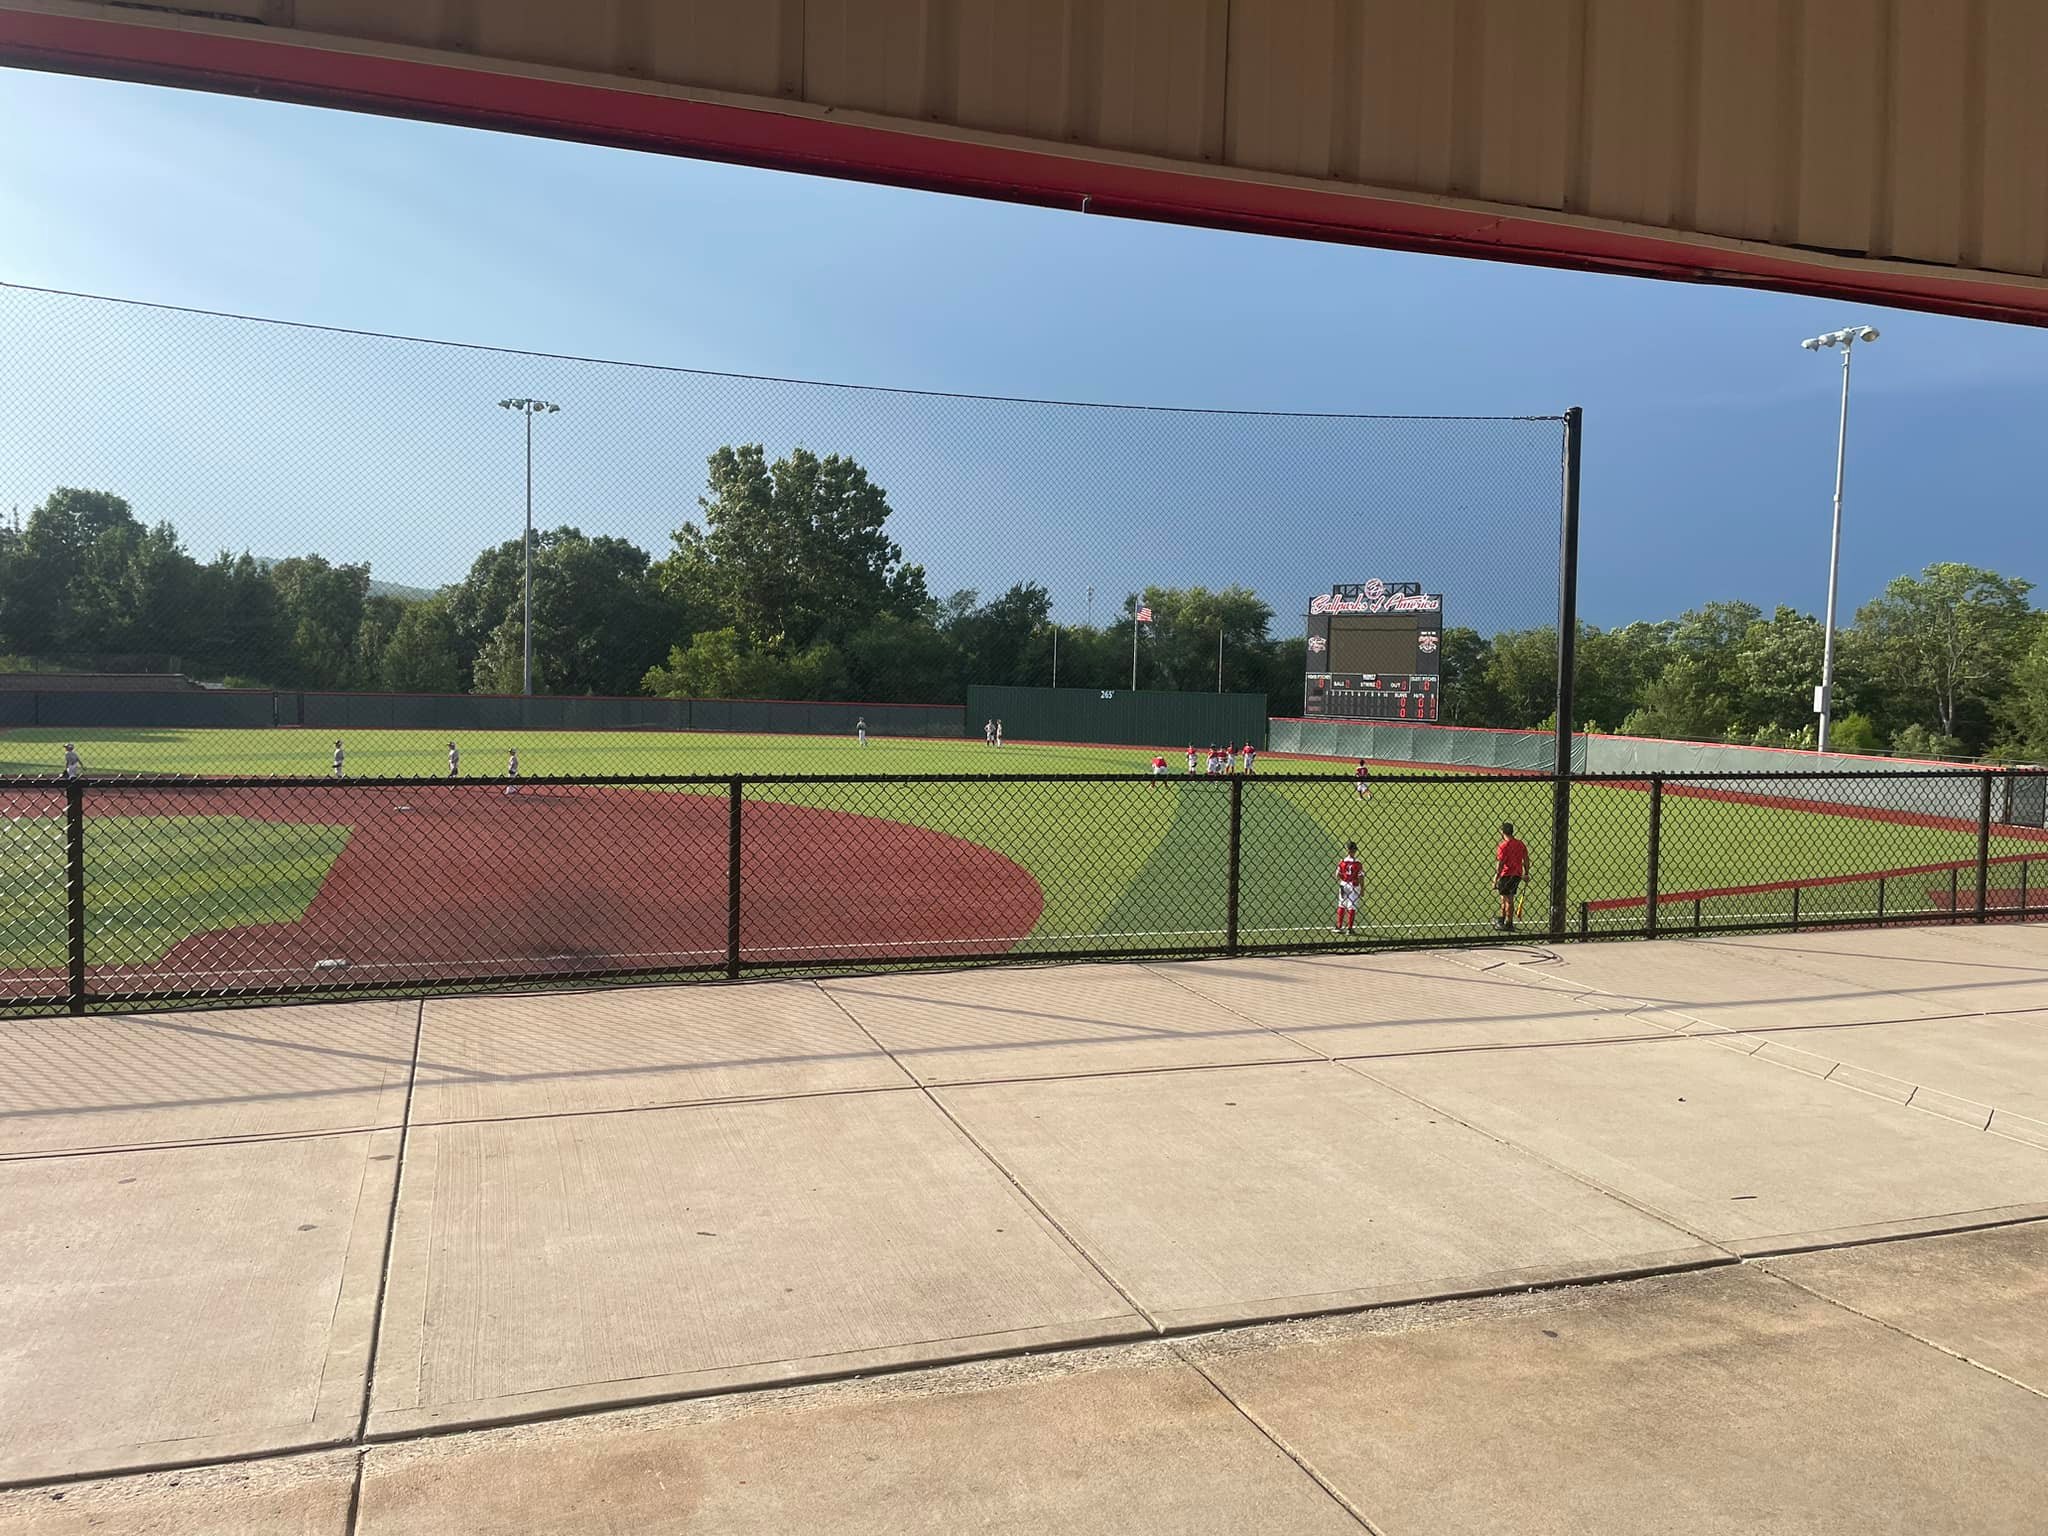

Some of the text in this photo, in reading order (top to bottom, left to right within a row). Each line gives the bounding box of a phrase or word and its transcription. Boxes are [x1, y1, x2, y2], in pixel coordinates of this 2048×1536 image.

[1311, 593, 1439, 615] Ballparks of America
